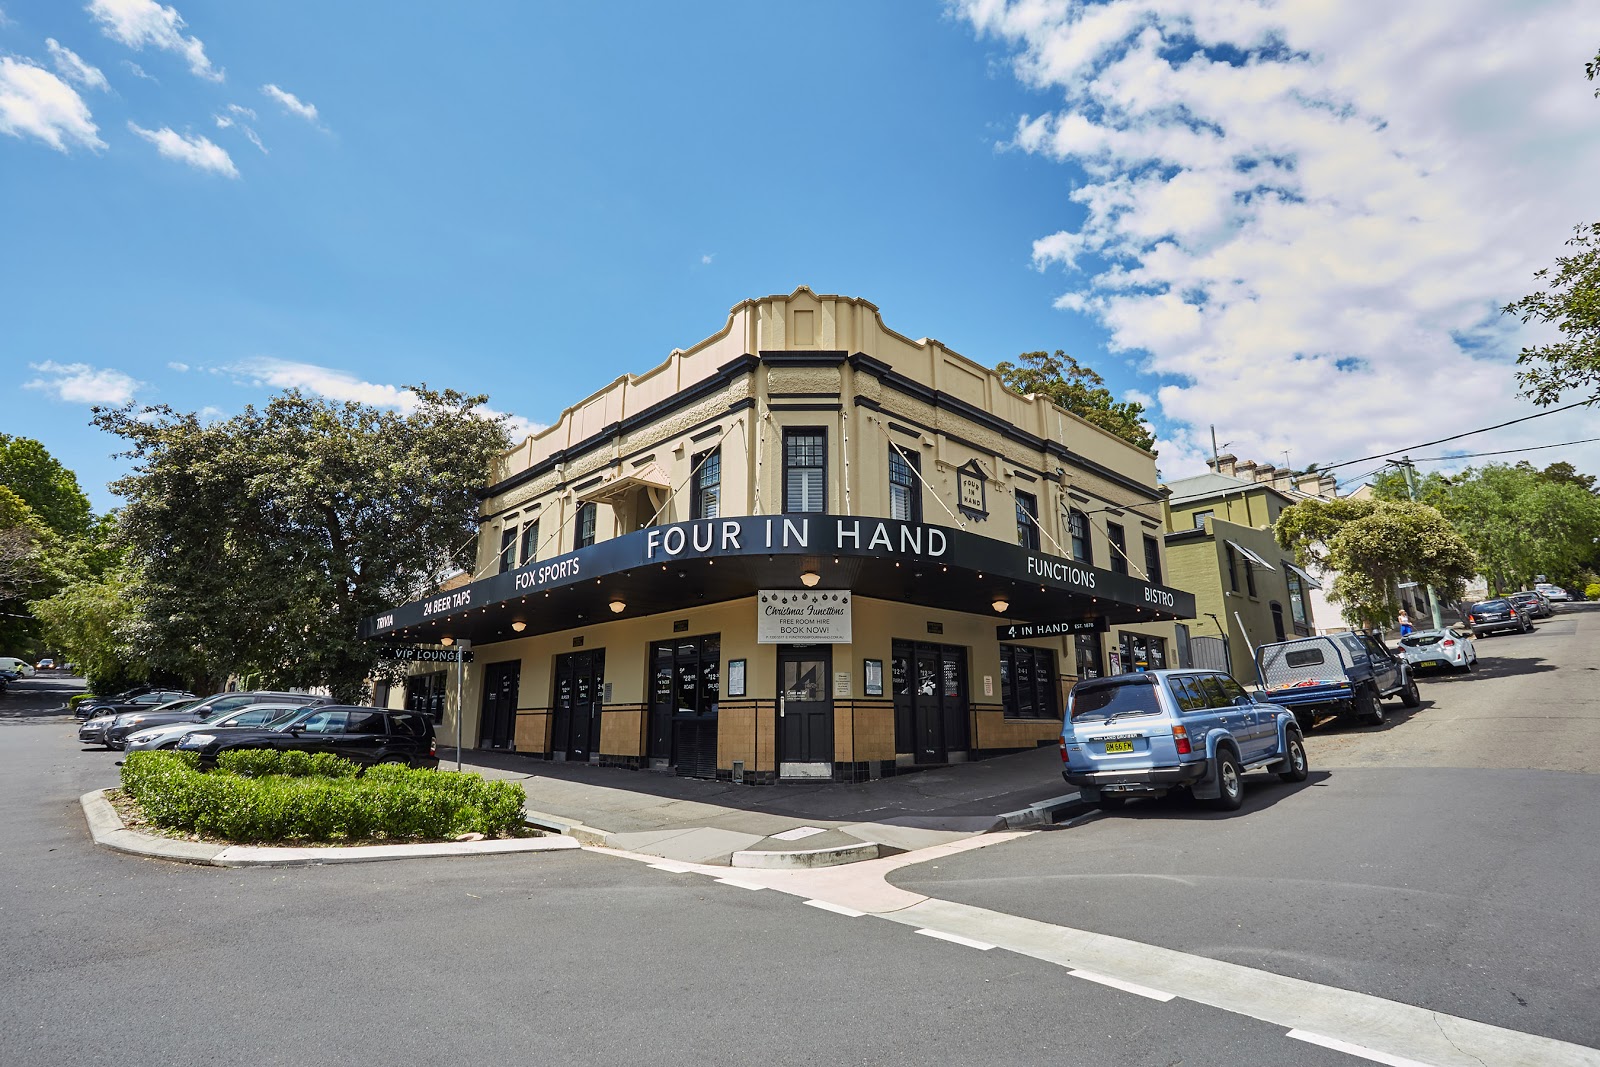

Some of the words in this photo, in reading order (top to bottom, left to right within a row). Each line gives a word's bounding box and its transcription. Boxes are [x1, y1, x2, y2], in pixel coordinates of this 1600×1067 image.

[963, 480, 980, 491] FOUR
[968, 488, 975, 496] IN
[964, 496, 981, 506] HAND
[647, 521, 741, 558] FOUR
[765, 518, 808, 548] IN
[837, 520, 947, 556] HAND
[515, 571, 536, 590] FOX
[538, 557, 580, 584] SPORTS
[1027, 556, 1096, 588] FUNCTIONS
[423, 602, 432, 616] 24
[433, 596, 451, 613] BEER
[453, 589, 471, 607] TAPS
[1144, 586, 1174, 607] BISTRO
[765, 605, 804, 616] Christmas
[806, 604, 844, 616] Functions
[376, 614, 394, 630] TRIVIA
[780, 626, 805, 634] BOOK
[806, 626, 830, 634] NOW!
[1021, 626, 1033, 636] IN
[1037, 623, 1069, 635] HAND
[395, 649, 413, 658] VIP
